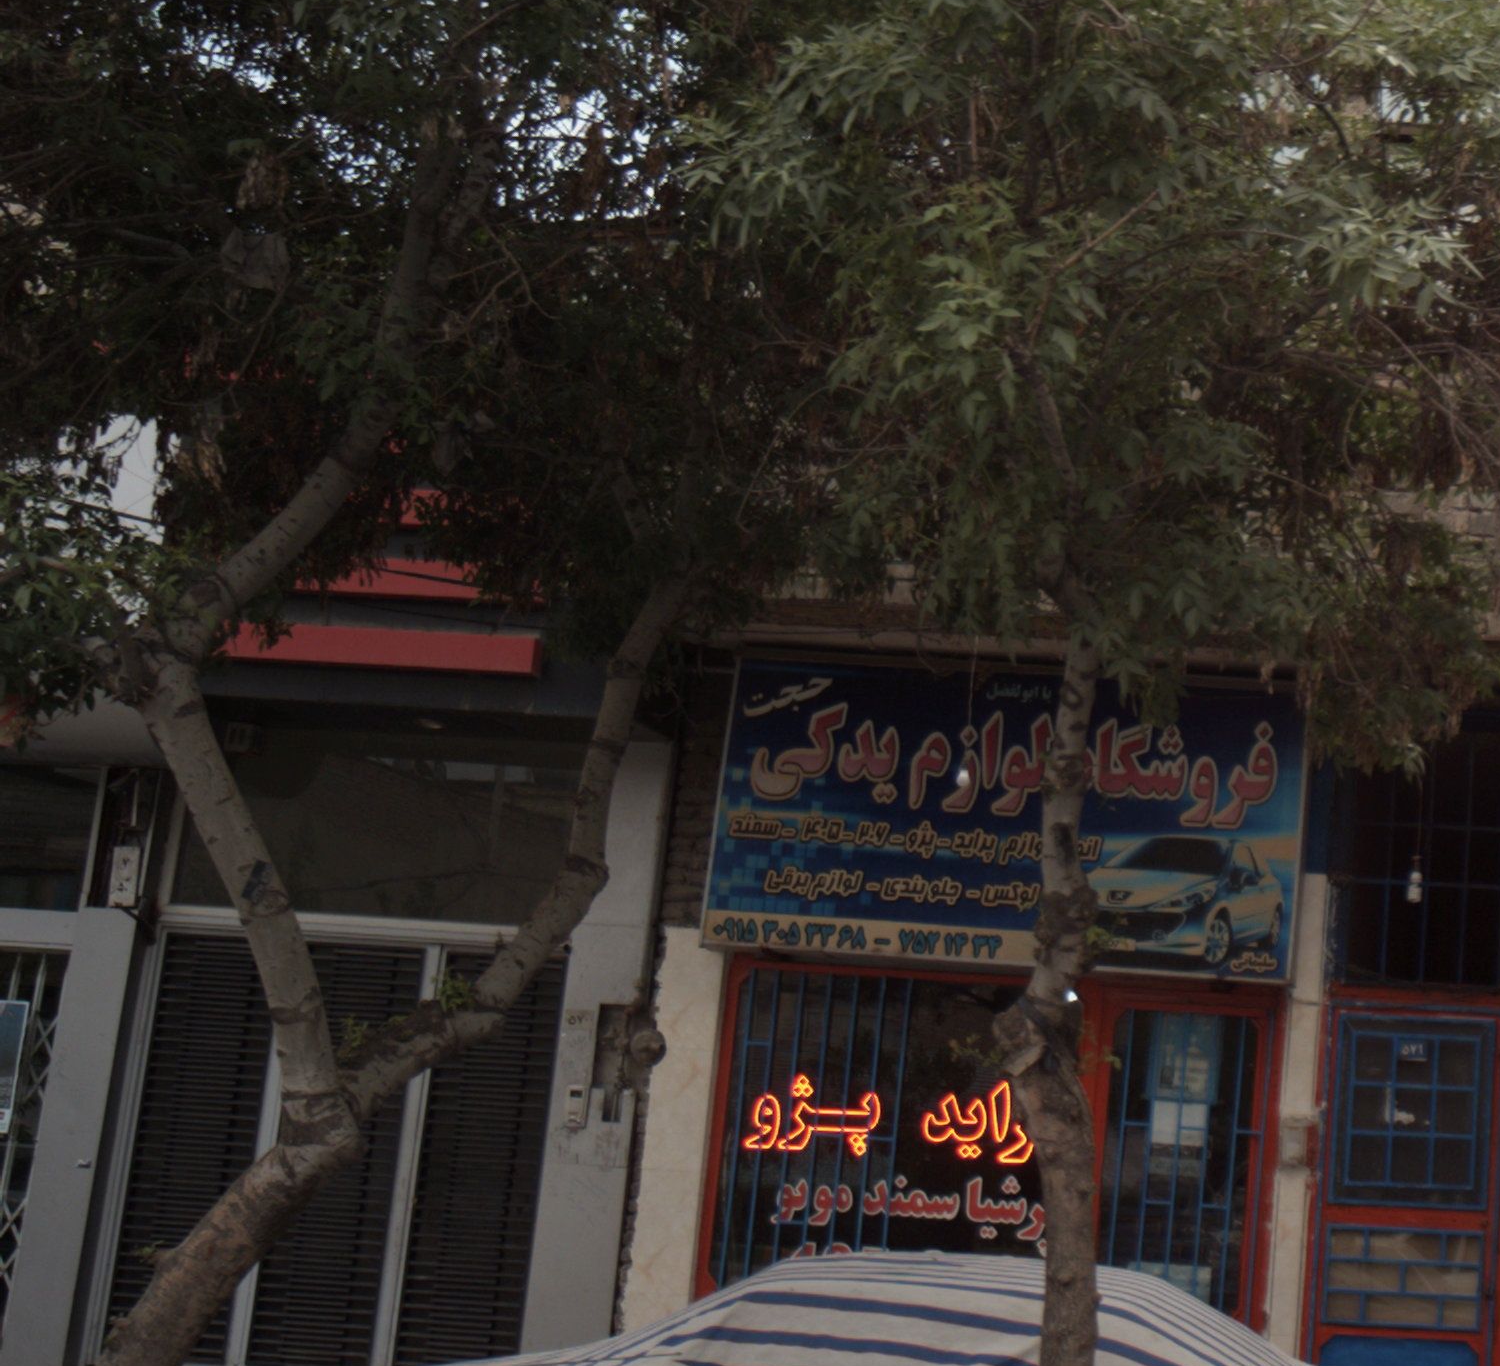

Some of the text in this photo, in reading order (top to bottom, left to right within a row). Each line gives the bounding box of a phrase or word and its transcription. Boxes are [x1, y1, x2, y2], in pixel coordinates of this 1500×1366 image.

[742, 677, 833, 717] حجت
[750, 702, 1278, 828] فروشگا لوازم یدکی
[729, 813, 782, 840] سمند
[906, 820, 937, 859] پژو
[951, 828, 999, 863] پراید
[998, 831, 1043, 866] وازم
[764, 866, 812, 895] برقی
[808, 869, 864, 900] لوازم
[979, 881, 1041, 910] لوکس
[740, 1071, 1036, 1164] راید پژو
[861, 1175, 960, 1220] سمند
[964, 1175, 1047, 1257] رشیا
